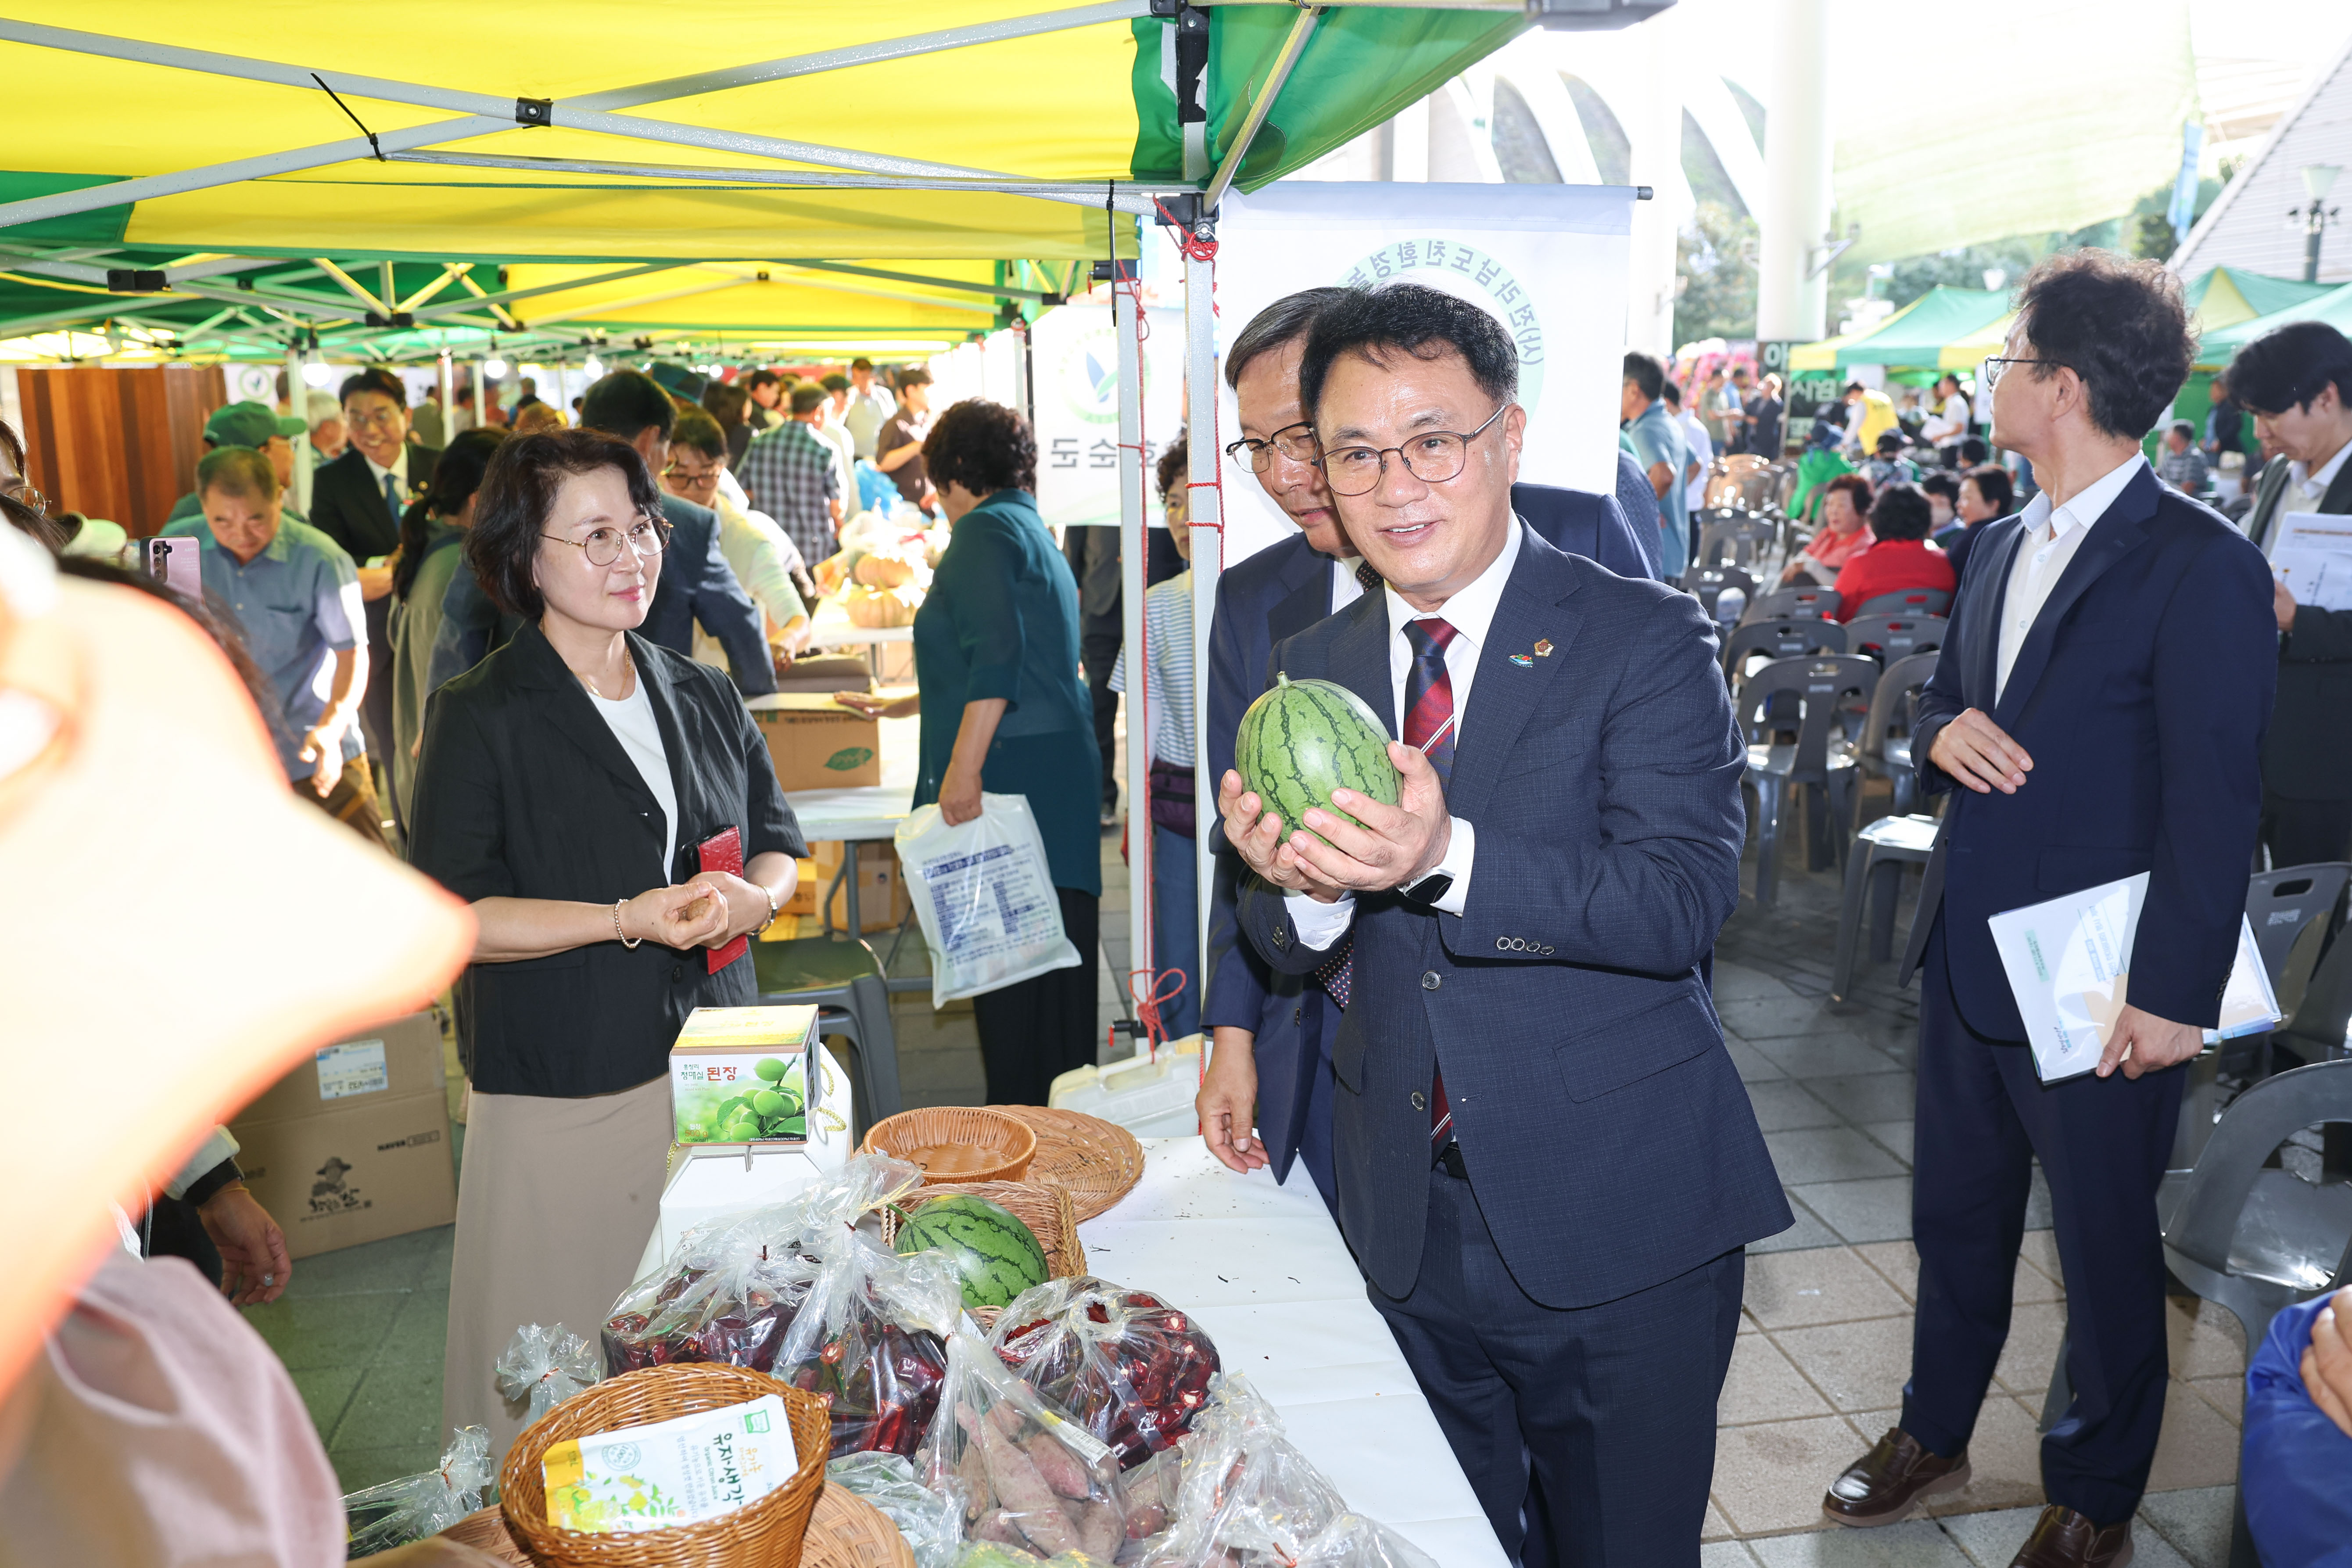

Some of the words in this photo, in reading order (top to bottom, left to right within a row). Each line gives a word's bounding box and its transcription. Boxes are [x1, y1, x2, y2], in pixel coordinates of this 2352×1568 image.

[681, 1071, 704, 1080] 청매실
[707, 1067, 737, 1081] 된장
[704, 1446, 713, 1467] Organic
[746, 1448, 764, 1473] 유기농
[713, 1433, 745, 1505] 유자생각
